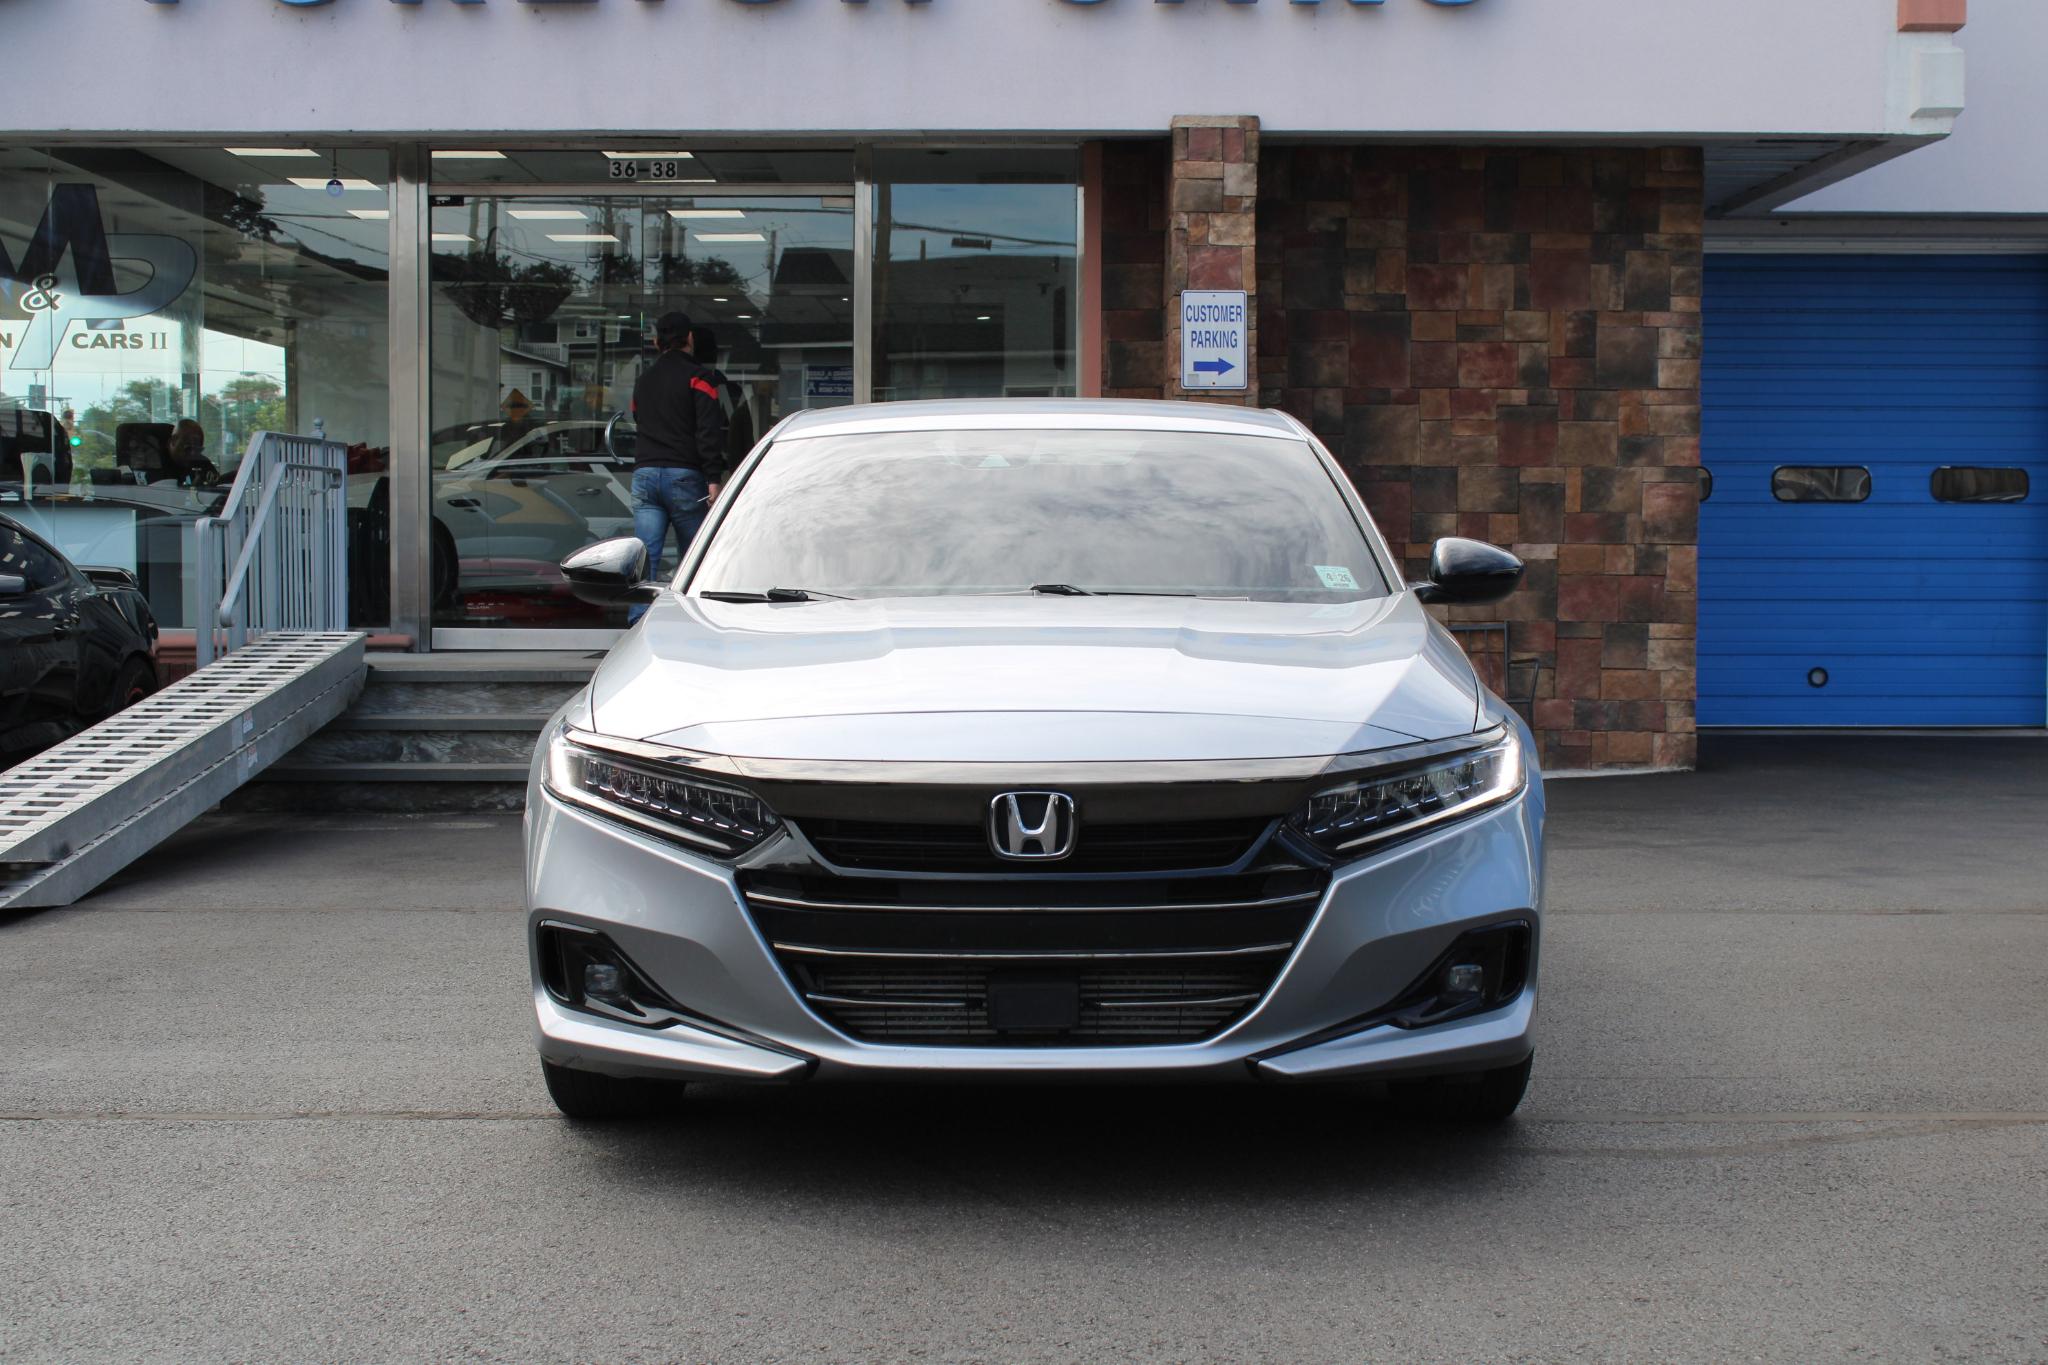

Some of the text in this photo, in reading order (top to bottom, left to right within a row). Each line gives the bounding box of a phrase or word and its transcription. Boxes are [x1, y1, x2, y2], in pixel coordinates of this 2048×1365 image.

[612, 161, 676, 178] 36-38
[1185, 304, 1243, 323] CUSTOMER
[71, 332, 144, 350] CARS
[1190, 329, 1238, 349] PARKING
